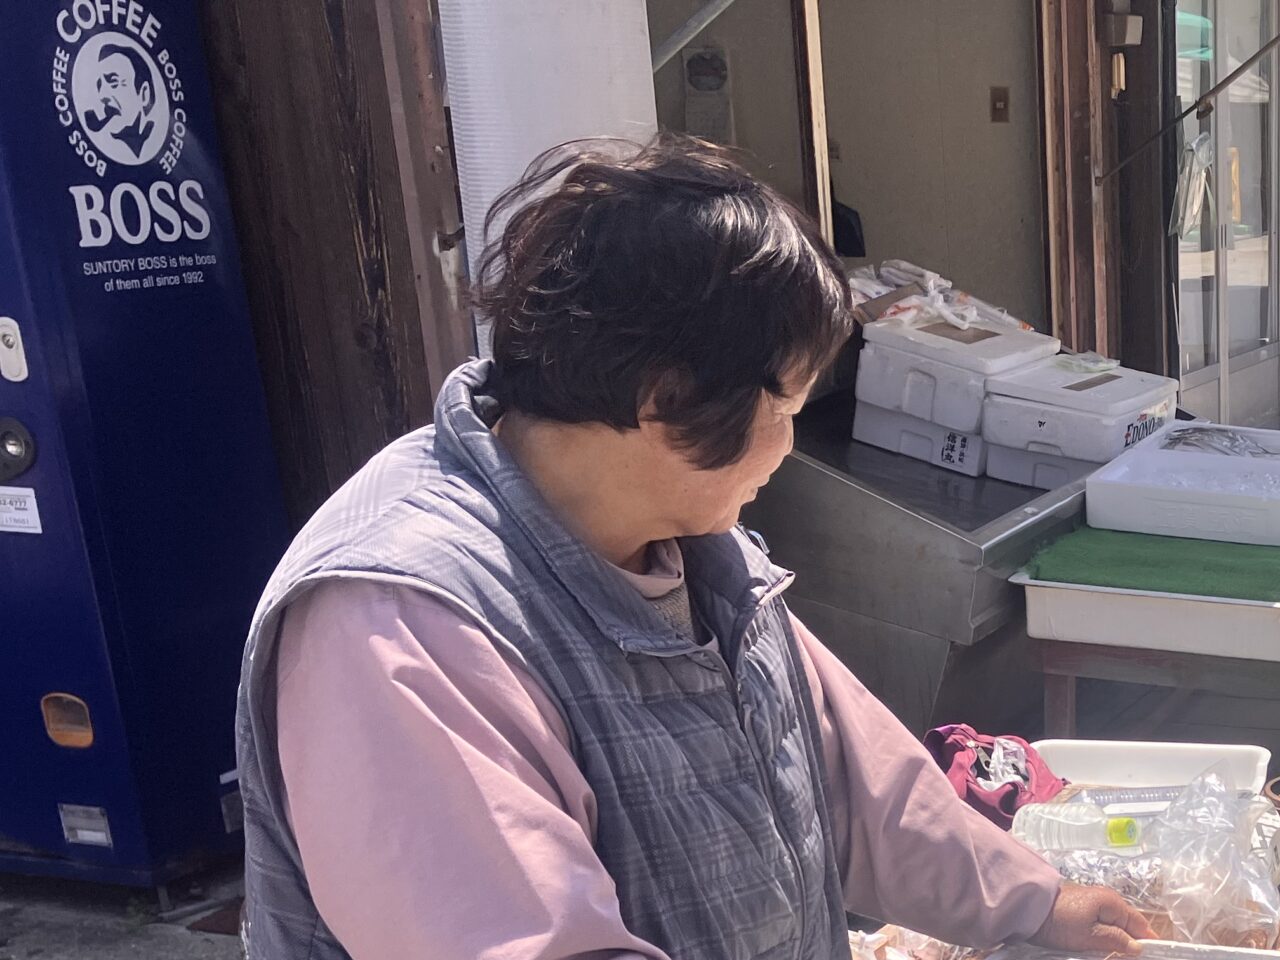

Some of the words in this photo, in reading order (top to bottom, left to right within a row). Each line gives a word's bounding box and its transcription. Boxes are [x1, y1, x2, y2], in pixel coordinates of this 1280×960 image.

[56, 0, 161, 48] COFFEE
[53, 46, 73, 126] COFFEE
[157, 48, 185, 102] BOSS
[68, 130, 107, 177] BOSS
[159, 108, 187, 175] COFFEE
[69, 179, 211, 247] BOSS
[83, 258, 136, 275] SUNTORY
[137, 256, 168, 270] BOSS
[169, 256, 178, 267] is
[179, 255, 194, 266] the
[195, 253, 217, 265] boss
[104, 279, 115, 292] of
[116, 278, 141, 290] them
[142, 275, 155, 288] all
[156, 274, 180, 287] since
[182, 271, 205, 284] 1992
